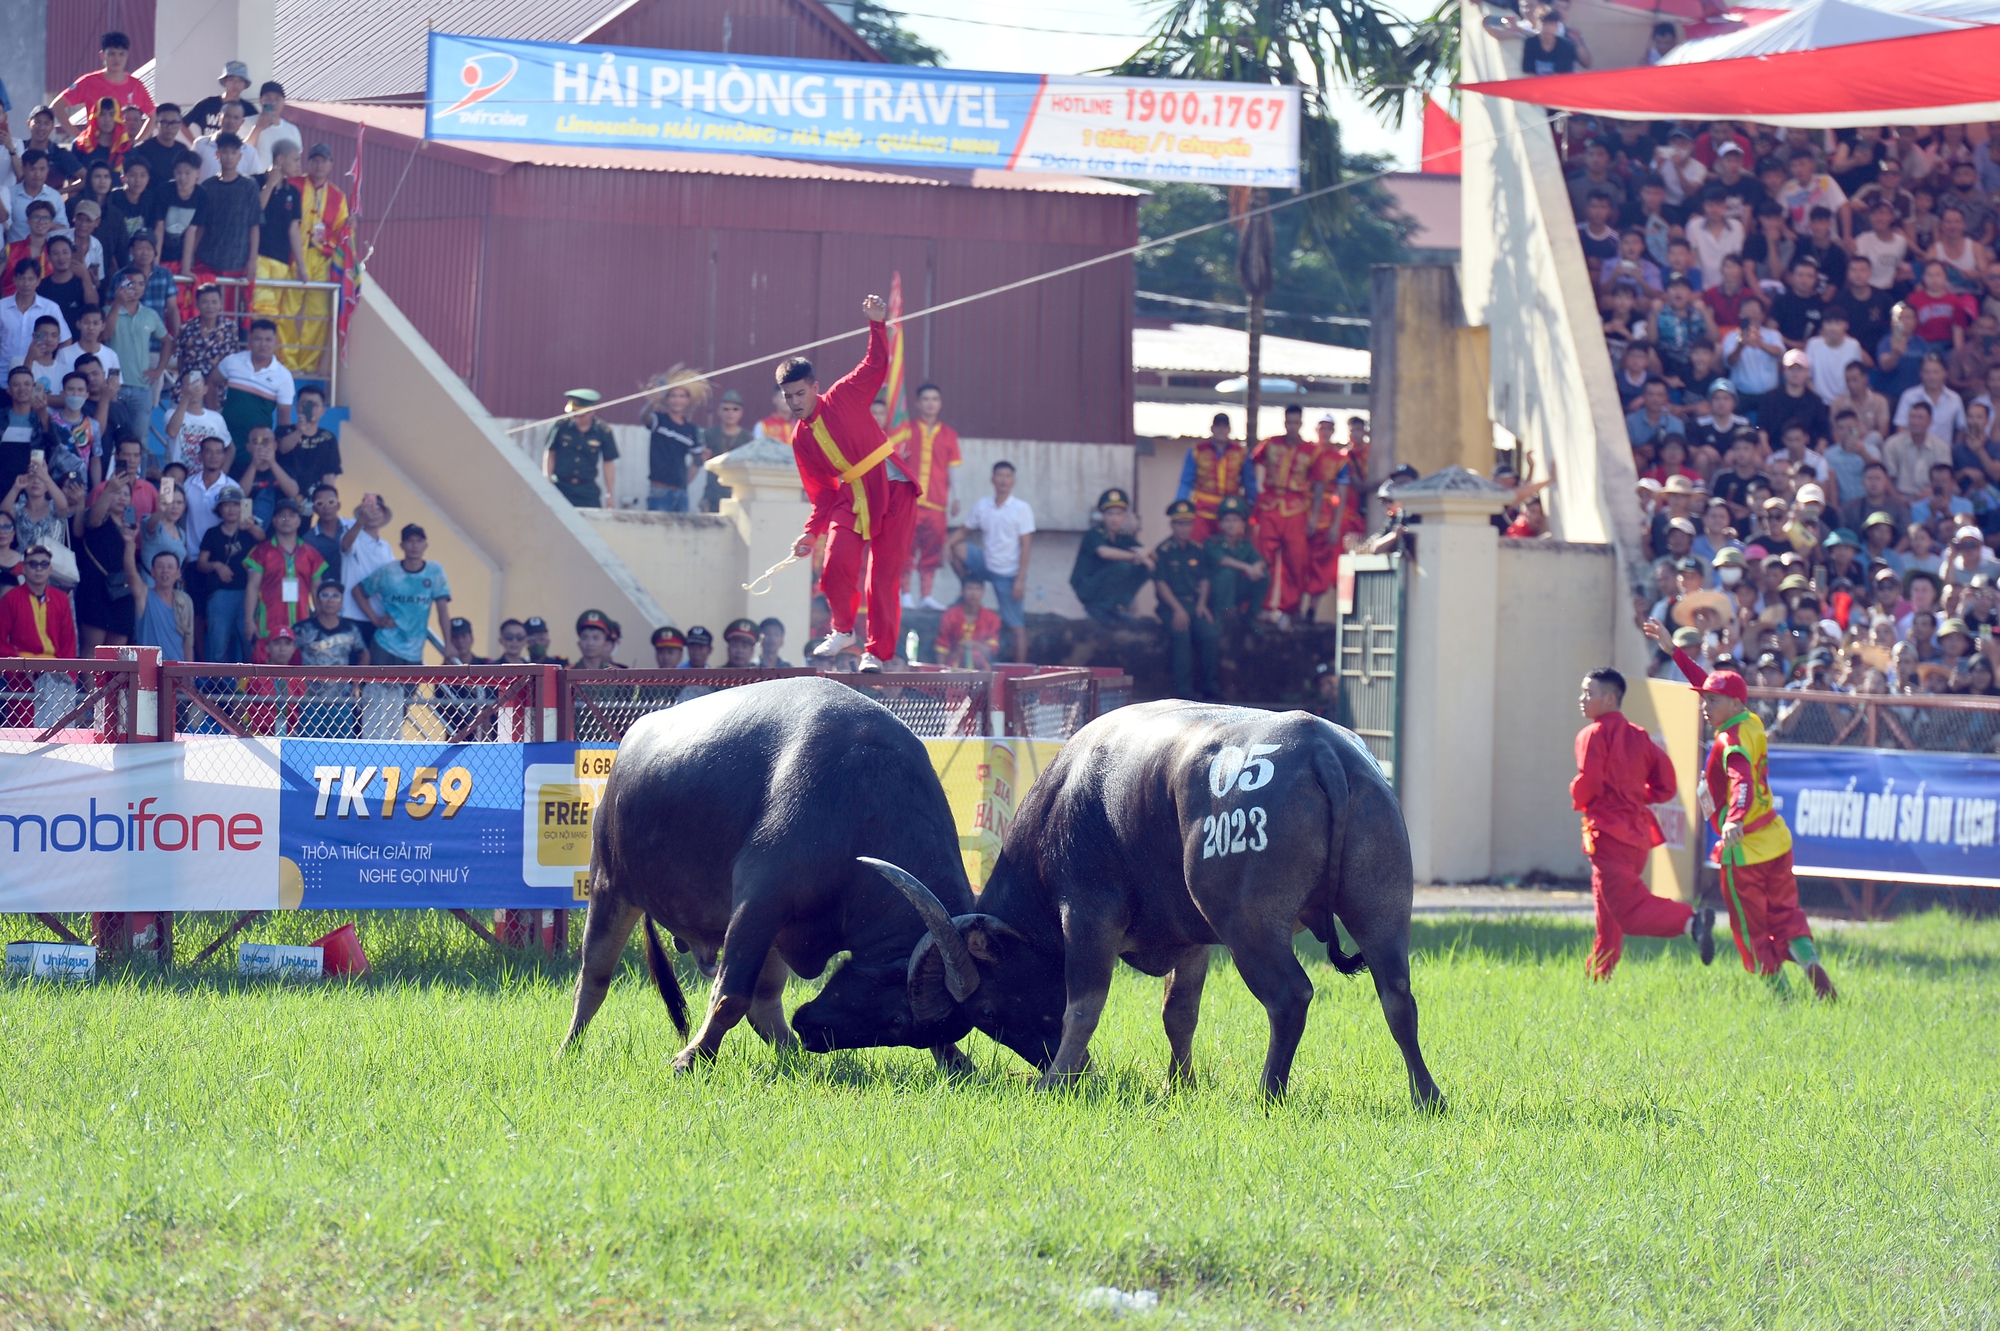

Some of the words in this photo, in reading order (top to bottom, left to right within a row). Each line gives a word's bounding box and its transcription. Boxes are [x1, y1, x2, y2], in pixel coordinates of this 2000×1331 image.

[553, 51, 639, 107] HẢI
[651, 63, 827, 119] PHÒNG
[833, 77, 1009, 129] TRAVEL
[1051, 94, 1113, 115] HOTLINE
[1125, 88, 1285, 131] 1900.1767
[556, 114, 660, 137] Limousine
[663, 117, 701, 139] HẢI
[703, 121, 776, 143] PHÒNG
[791, 125, 820, 146] HÀ
[824, 127, 862, 150] NỘI
[876, 129, 948, 153] QUẢNG
[951, 137, 999, 155] NINH
[1096, 128, 1149, 154] tiếng
[1178, 136, 1252, 159] chuyến
[582, 757, 590, 775] 6
[593, 757, 611, 775] GB
[1209, 743, 1282, 798] 05
[314, 766, 473, 820] TK159
[993, 777, 1011, 807] BIA
[0, 797, 263, 852] mobifone
[544, 801, 590, 826] FREE
[1794, 775, 1866, 839] CHUYỂN
[1865, 777, 1898, 841] ĐỔI
[1898, 780, 1926, 843] SỐ
[1925, 796, 1952, 844] DU
[1954, 797, 1997, 855] LỊCH
[544, 830, 559, 840] GỌI
[559, 830, 570, 840] NỘI
[571, 830, 587, 840] MẠNG
[1203, 806, 1268, 860] 2023
[301, 841, 338, 859] THỎA
[341, 842, 380, 860] THÍCH
[382, 841, 411, 860] GIẢI
[415, 843, 433, 860] TRÍ
[359, 868, 397, 883] NGHE
[400, 868, 427, 886] GỌI
[430, 867, 458, 883] NHƯ
[461, 866, 470, 883] Ý
[42, 953, 89, 968] UniAqua
[281, 955, 318, 968] UniAqua
